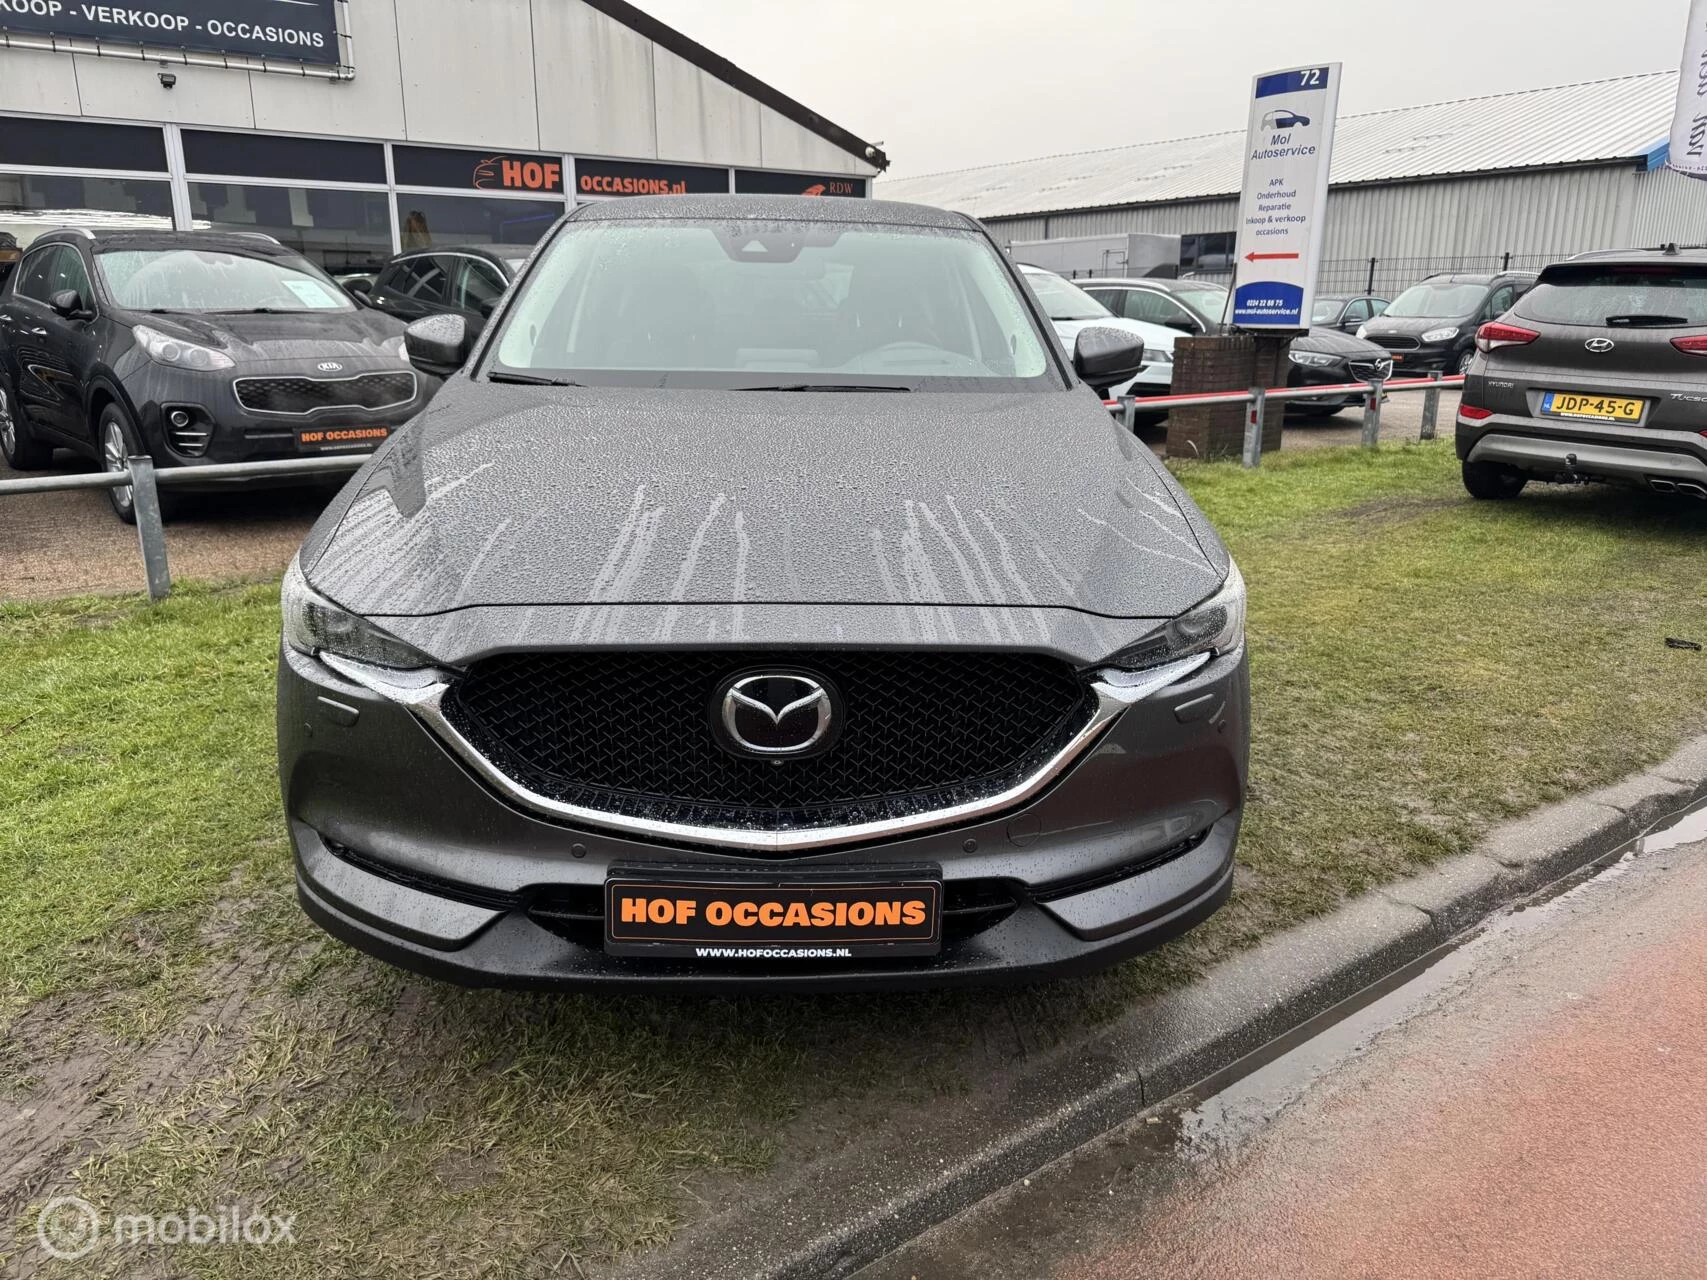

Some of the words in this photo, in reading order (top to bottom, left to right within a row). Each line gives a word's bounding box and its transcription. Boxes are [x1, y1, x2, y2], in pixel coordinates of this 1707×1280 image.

[81, 4, 189, 31] VERKOOP
[207, 19, 324, 47] OCCASIONS
[1300, 69, 1320, 86] 72
[1270, 133, 1291, 146] Mol
[1251, 145, 1316, 161] Autoservice
[502, 160, 560, 189] HOF
[580, 175, 686, 195] OCCASIONS.nl
[1269, 178, 1284, 186] APK
[829, 181, 853, 194] RDW
[1257, 189, 1297, 200] Onderhoud
[1258, 202, 1292, 213] Reparatie
[1246, 216, 1267, 225] Inkoop
[1267, 215, 1274, 223] &
[1275, 214, 1306, 224] verkoop
[1255, 227, 1289, 236] occasions
[1556, 396, 1635, 416] JDP-45-G
[301, 432, 323, 442] HOF
[326, 428, 388, 440] OCCASIONS
[621, 898, 697, 925] HOF
[705, 900, 926, 927] OCCASIONS
[696, 948, 852, 958] WWW.HOFOCCASIONS.NL
